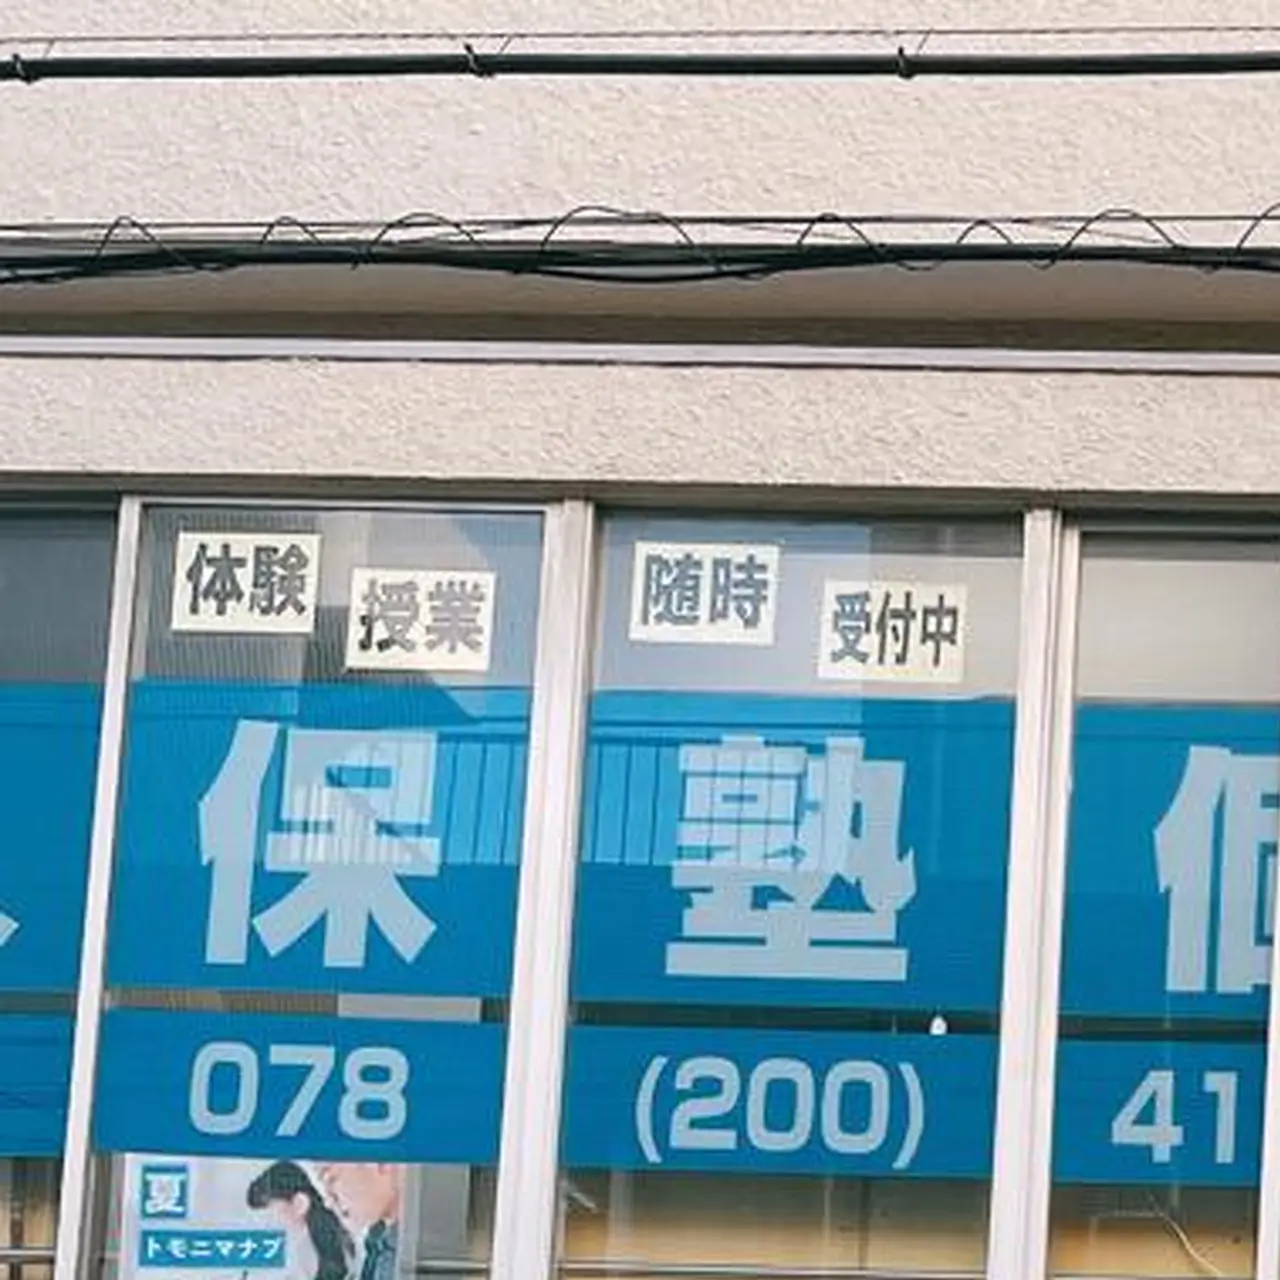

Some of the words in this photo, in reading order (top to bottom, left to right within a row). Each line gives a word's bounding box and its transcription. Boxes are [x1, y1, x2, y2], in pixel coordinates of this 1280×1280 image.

[185, 545, 309, 619] 体験
[359, 579, 488, 656] 授業
[641, 553, 770, 633] 随時
[830, 589, 959, 670] 受付中
[188, 1041, 410, 1141] 078
[637, 1054, 925, 1167] (200)
[1111, 1069, 1242, 1165] 41
[144, 1171, 186, 1214] 夏
